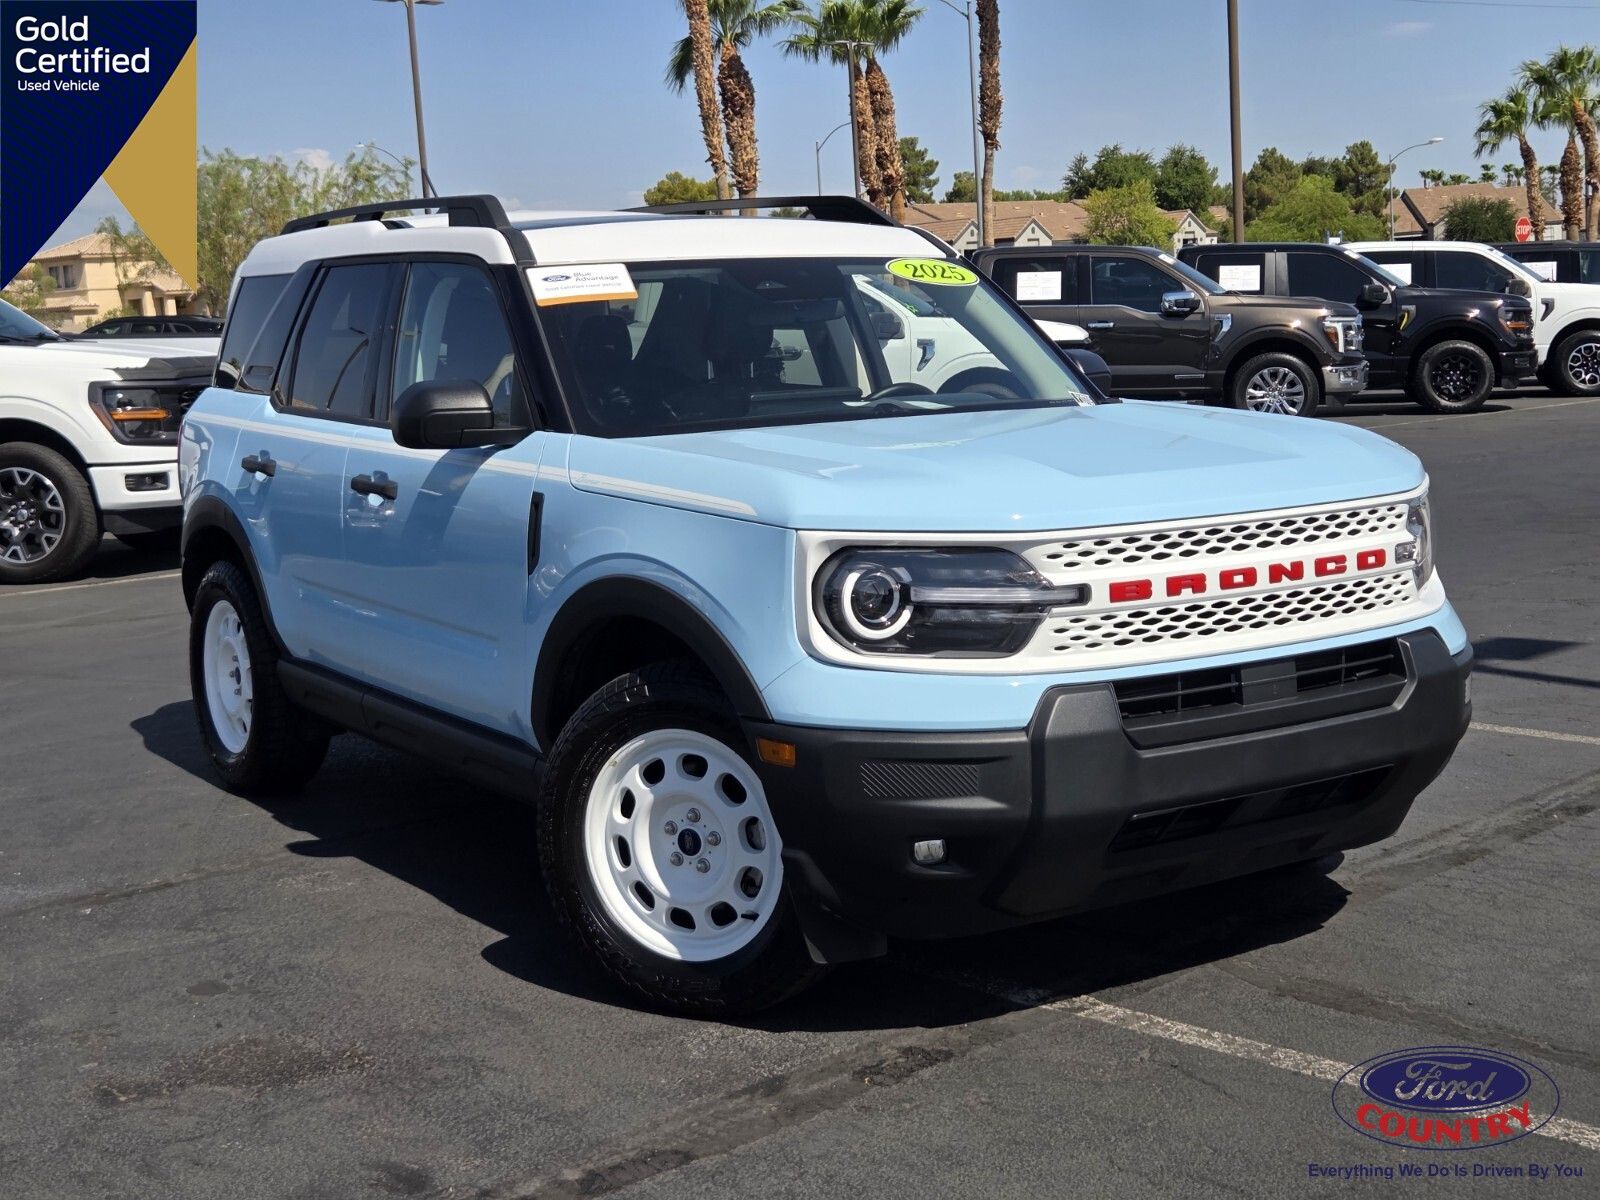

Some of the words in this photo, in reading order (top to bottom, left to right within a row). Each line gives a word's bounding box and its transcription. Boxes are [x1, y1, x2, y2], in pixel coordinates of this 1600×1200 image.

[1517, 225, 1530, 235] STOP
[904, 263, 966, 281] 2025
[1109, 548, 1386, 603] BRONCO
